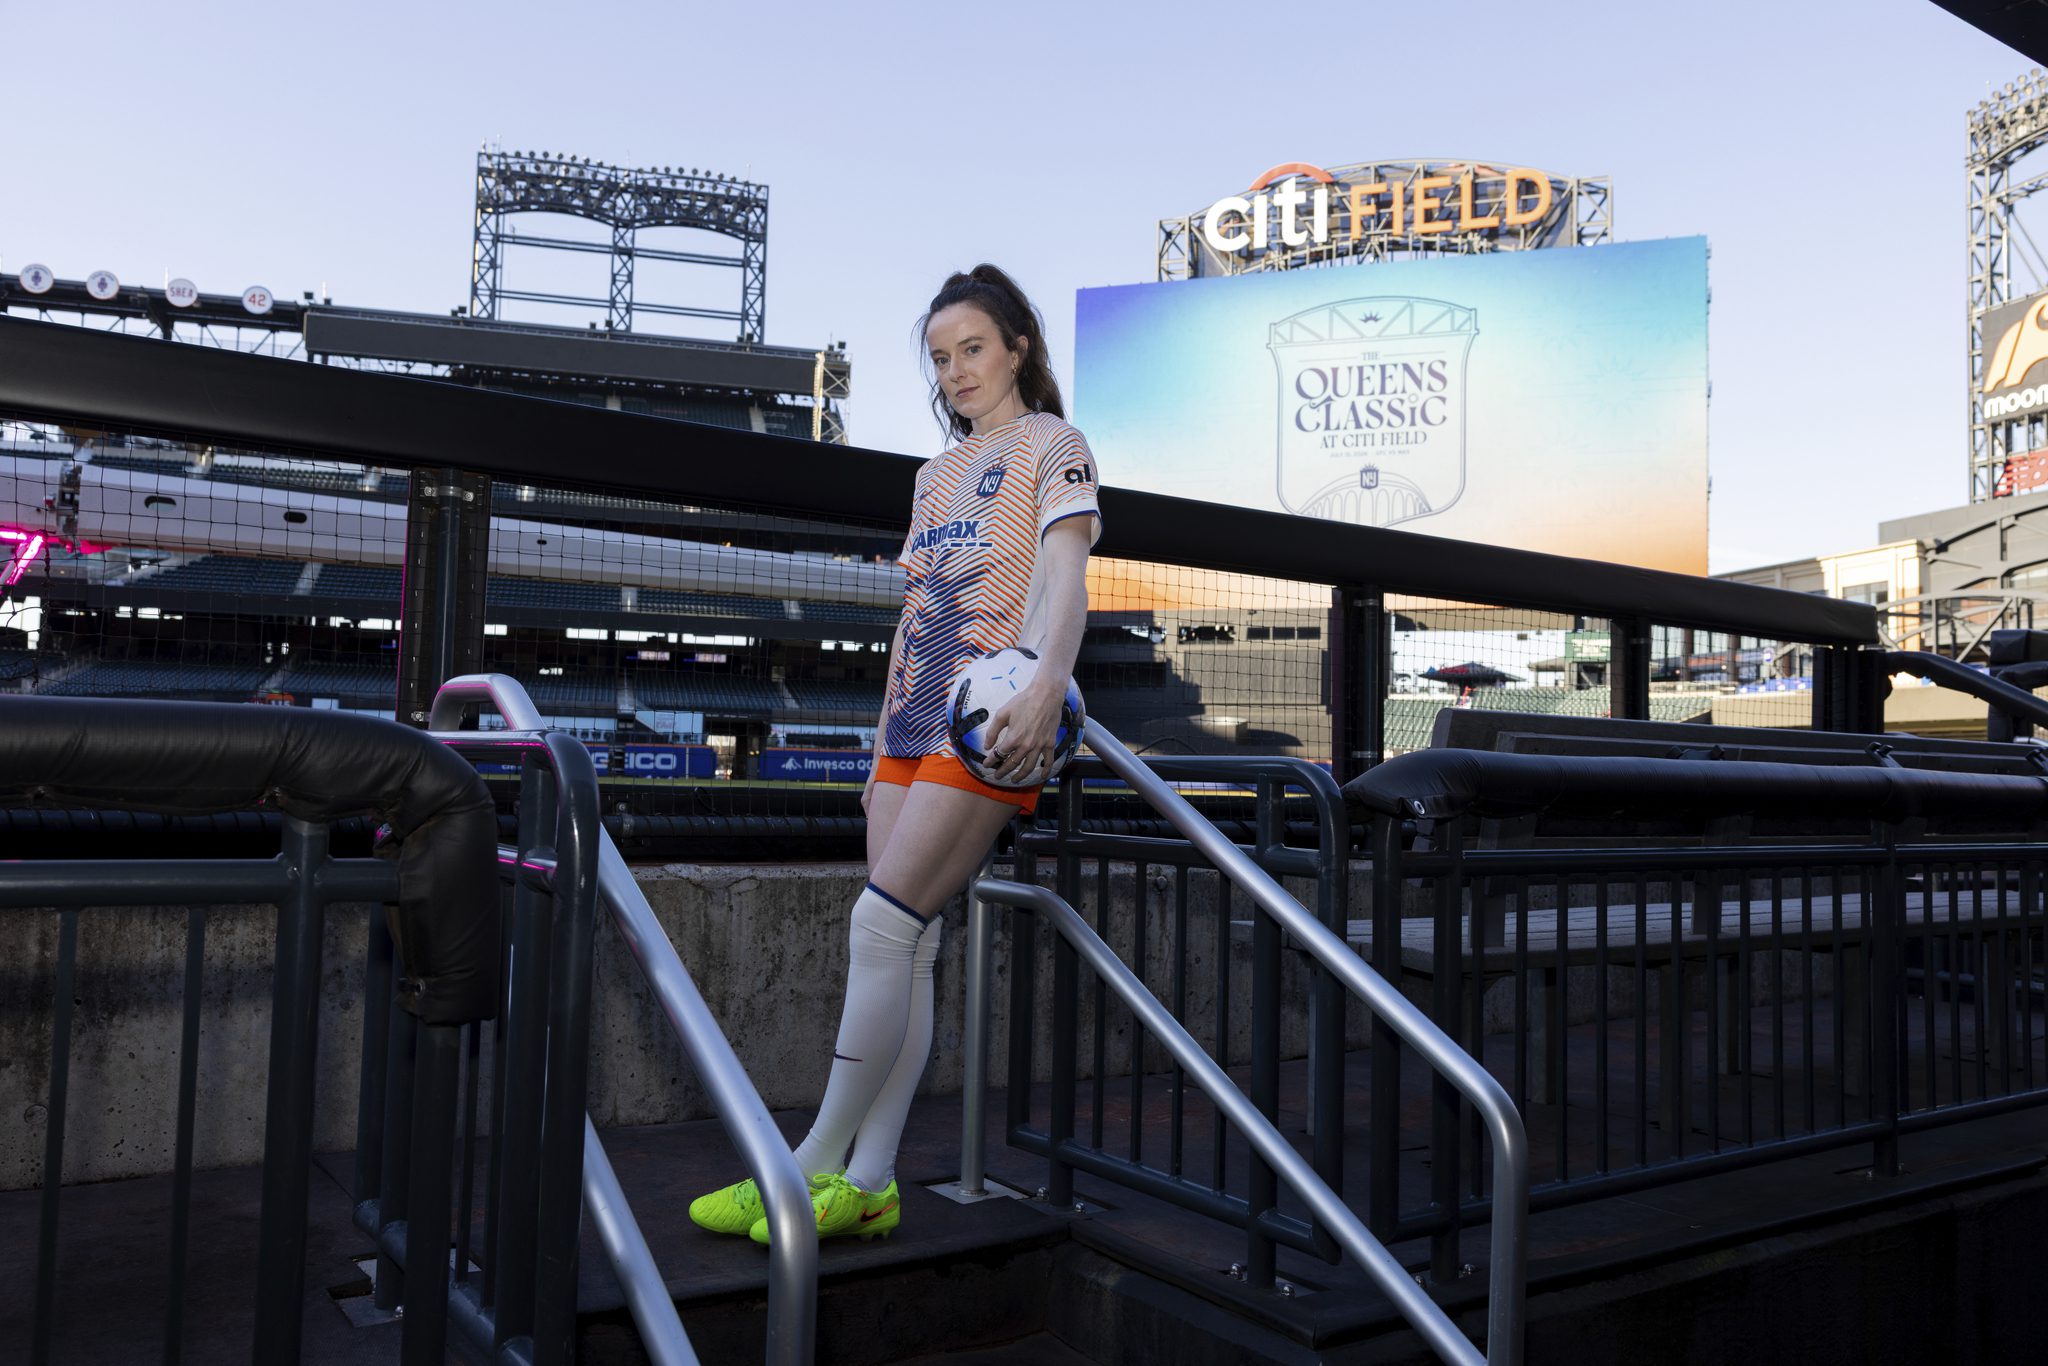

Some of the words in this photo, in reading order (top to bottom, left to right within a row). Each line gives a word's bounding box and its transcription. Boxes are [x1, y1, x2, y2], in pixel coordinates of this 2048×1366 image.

[1350, 168, 1552, 240] FIELD
[169, 286, 194, 298] SHEA
[248, 293, 267, 308] 42
[1362, 351, 1380, 361] THE
[1295, 360, 1448, 406] QUEENS
[1320, 435, 1338, 449] AT
[1342, 432, 1376, 448] CITI
[1381, 430, 1428, 446] FIELD
[979, 474, 1001, 492] NY
[591, 752, 677, 770] GICO
[803, 758, 855, 771] Invesco
